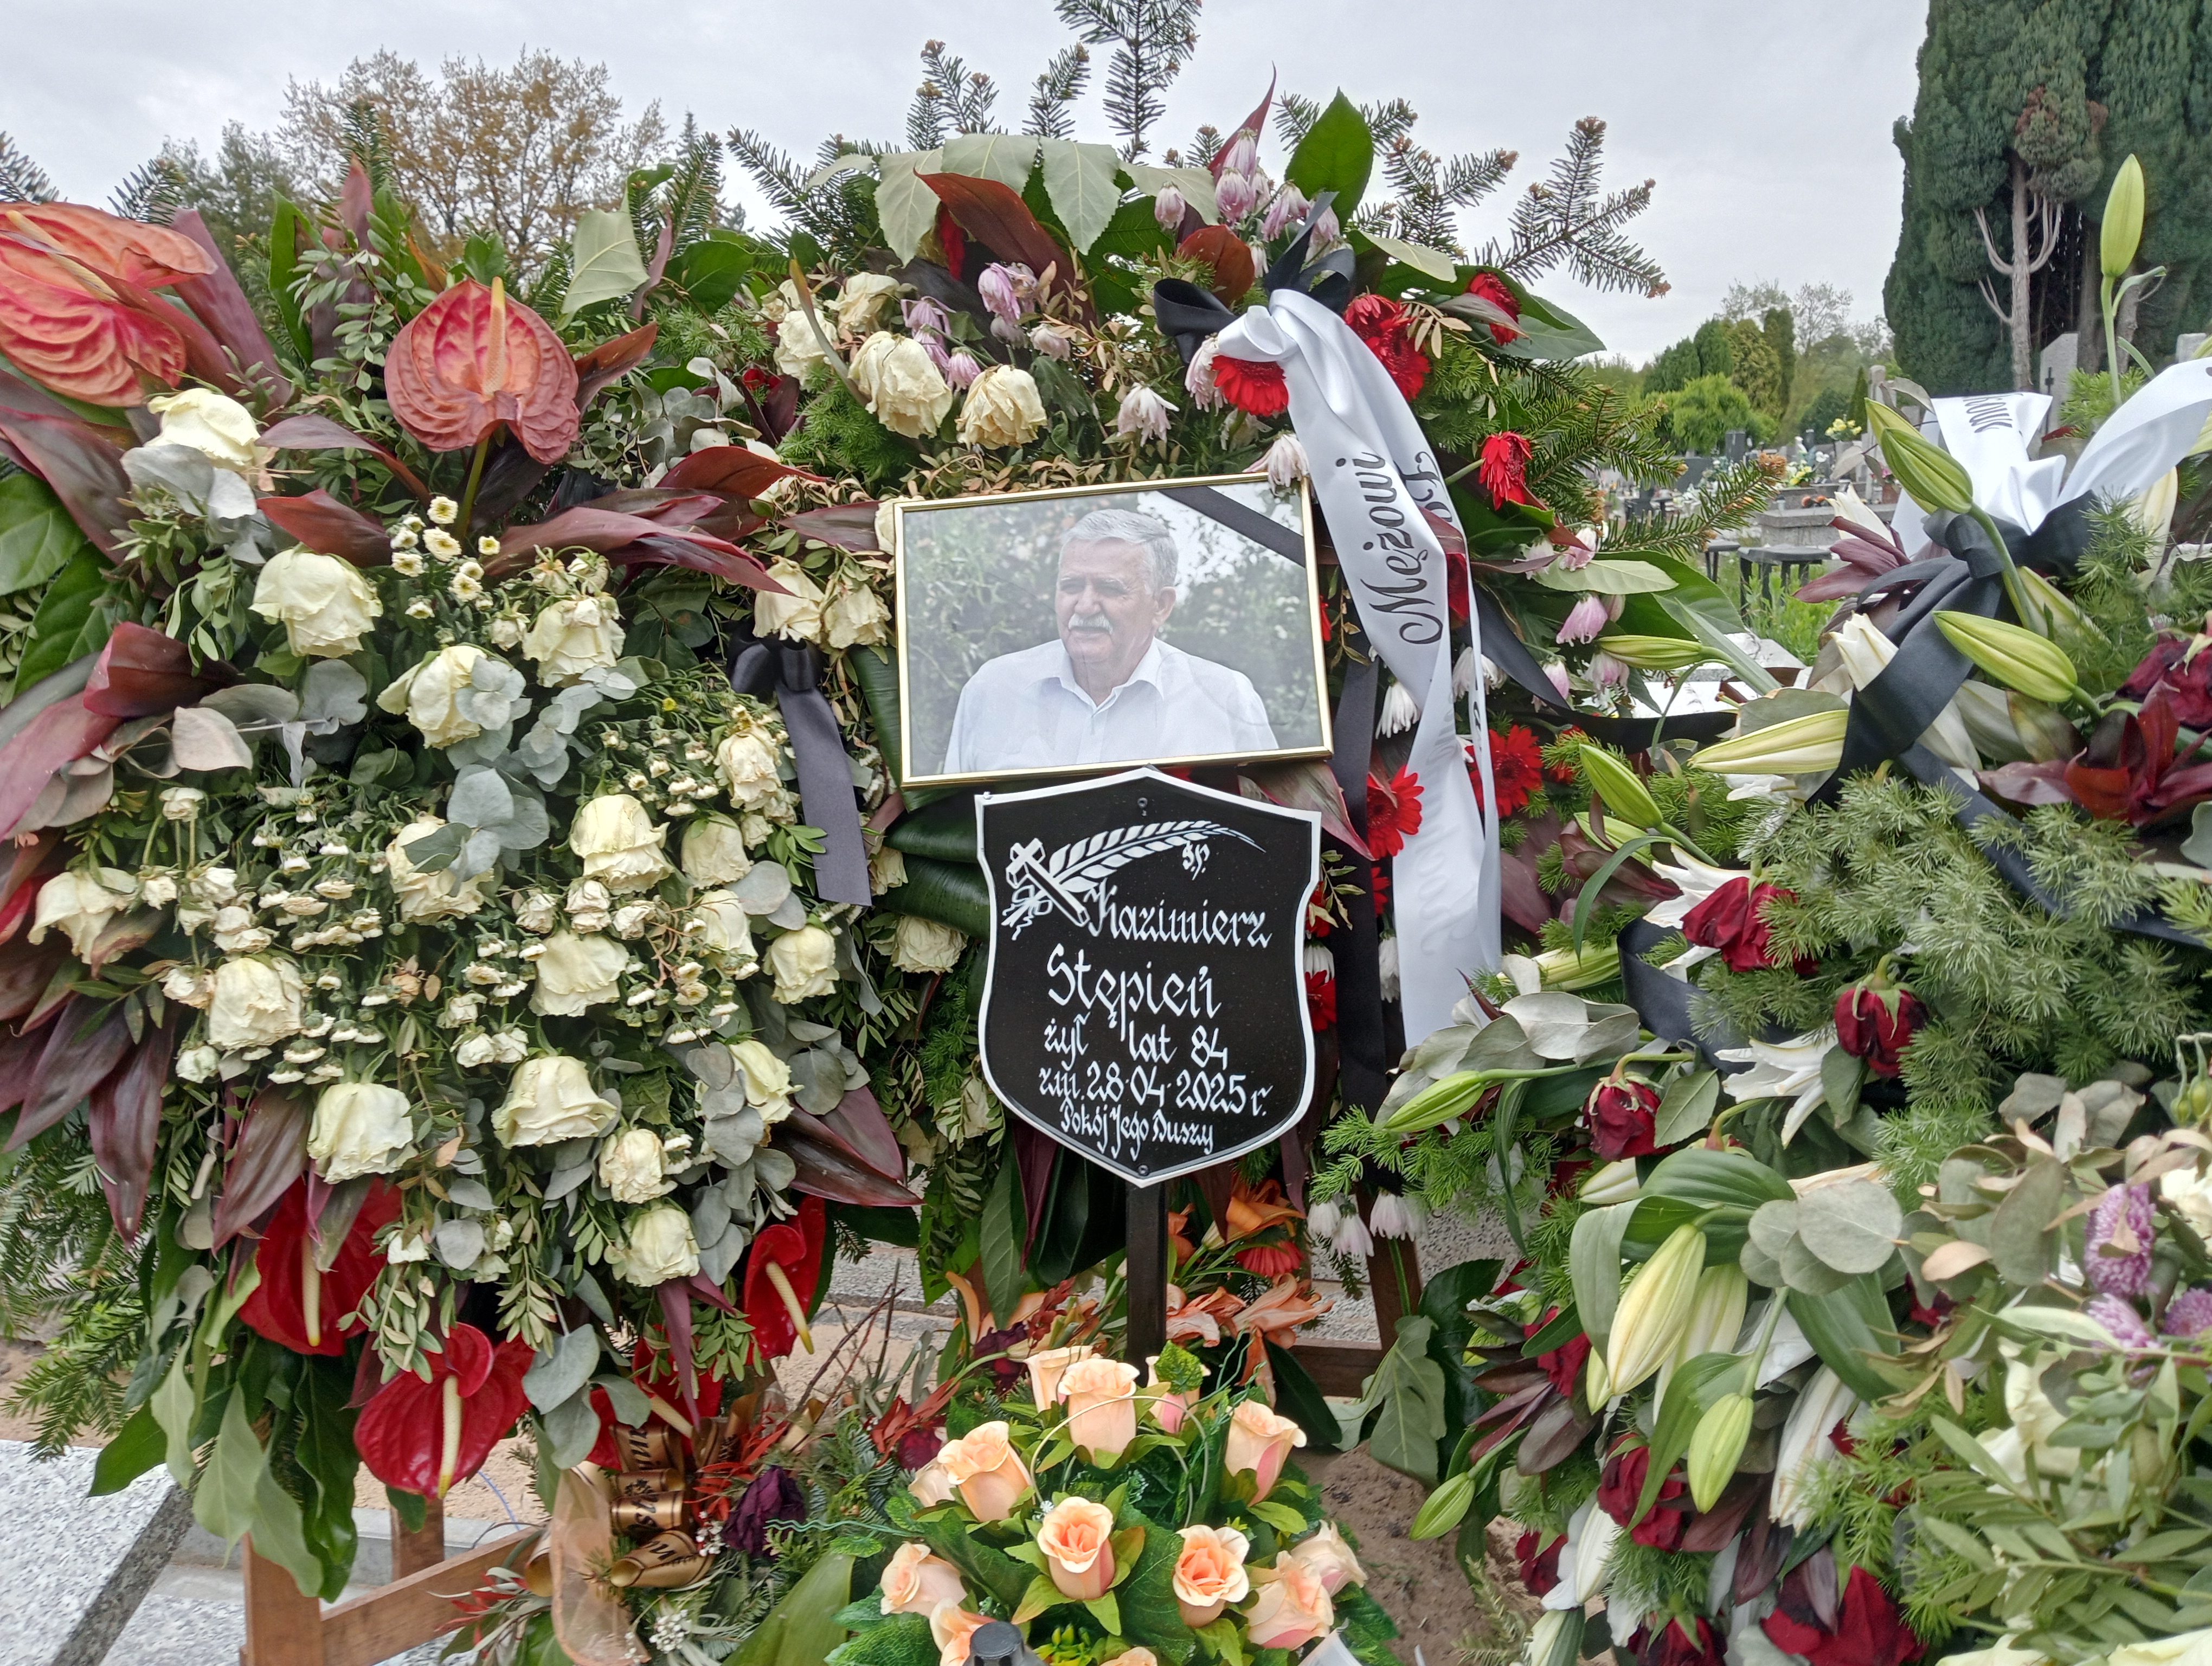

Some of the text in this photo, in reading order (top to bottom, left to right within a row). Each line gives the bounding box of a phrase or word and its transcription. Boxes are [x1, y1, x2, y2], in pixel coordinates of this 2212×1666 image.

[1335, 452, 1443, 645] Mężowi
[1082, 877, 1272, 949] Kazimierz
[1046, 943, 1222, 1042] Stępień
[1128, 1020, 1178, 1065] lat
[1191, 1024, 1229, 1071] 84
[1250, 1085, 1274, 1117] r.
